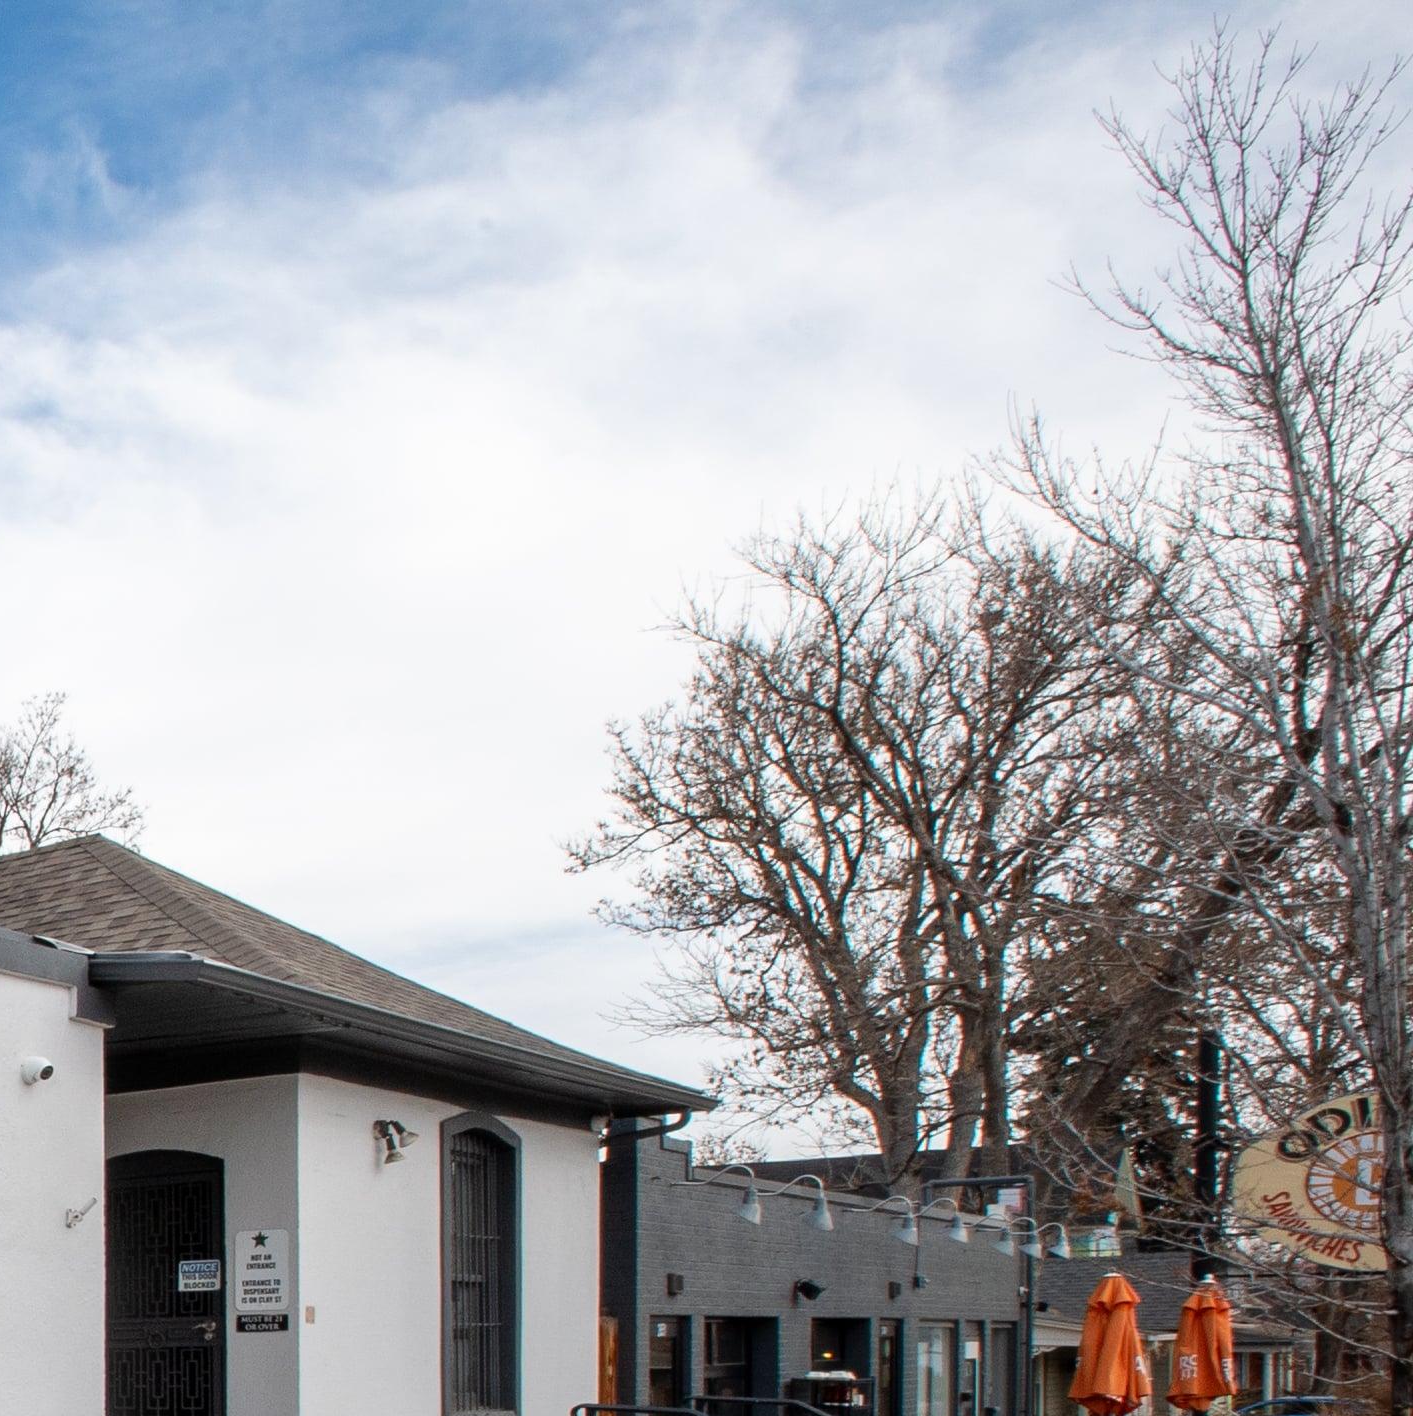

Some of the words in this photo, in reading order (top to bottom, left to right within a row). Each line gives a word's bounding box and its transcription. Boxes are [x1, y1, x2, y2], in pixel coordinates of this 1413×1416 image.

[181, 1262, 218, 1272] NOTICE
[246, 1262, 276, 1270] ENTRANCE
[198, 1272, 217, 1280] DOOR
[184, 1281, 216, 1289] BLOCKED
[243, 1287, 280, 1295] DISPENSARY
[258, 1296, 273, 1304] CLAY
[245, 1323, 257, 1331] OR
[257, 1323, 279, 1331] OVER
